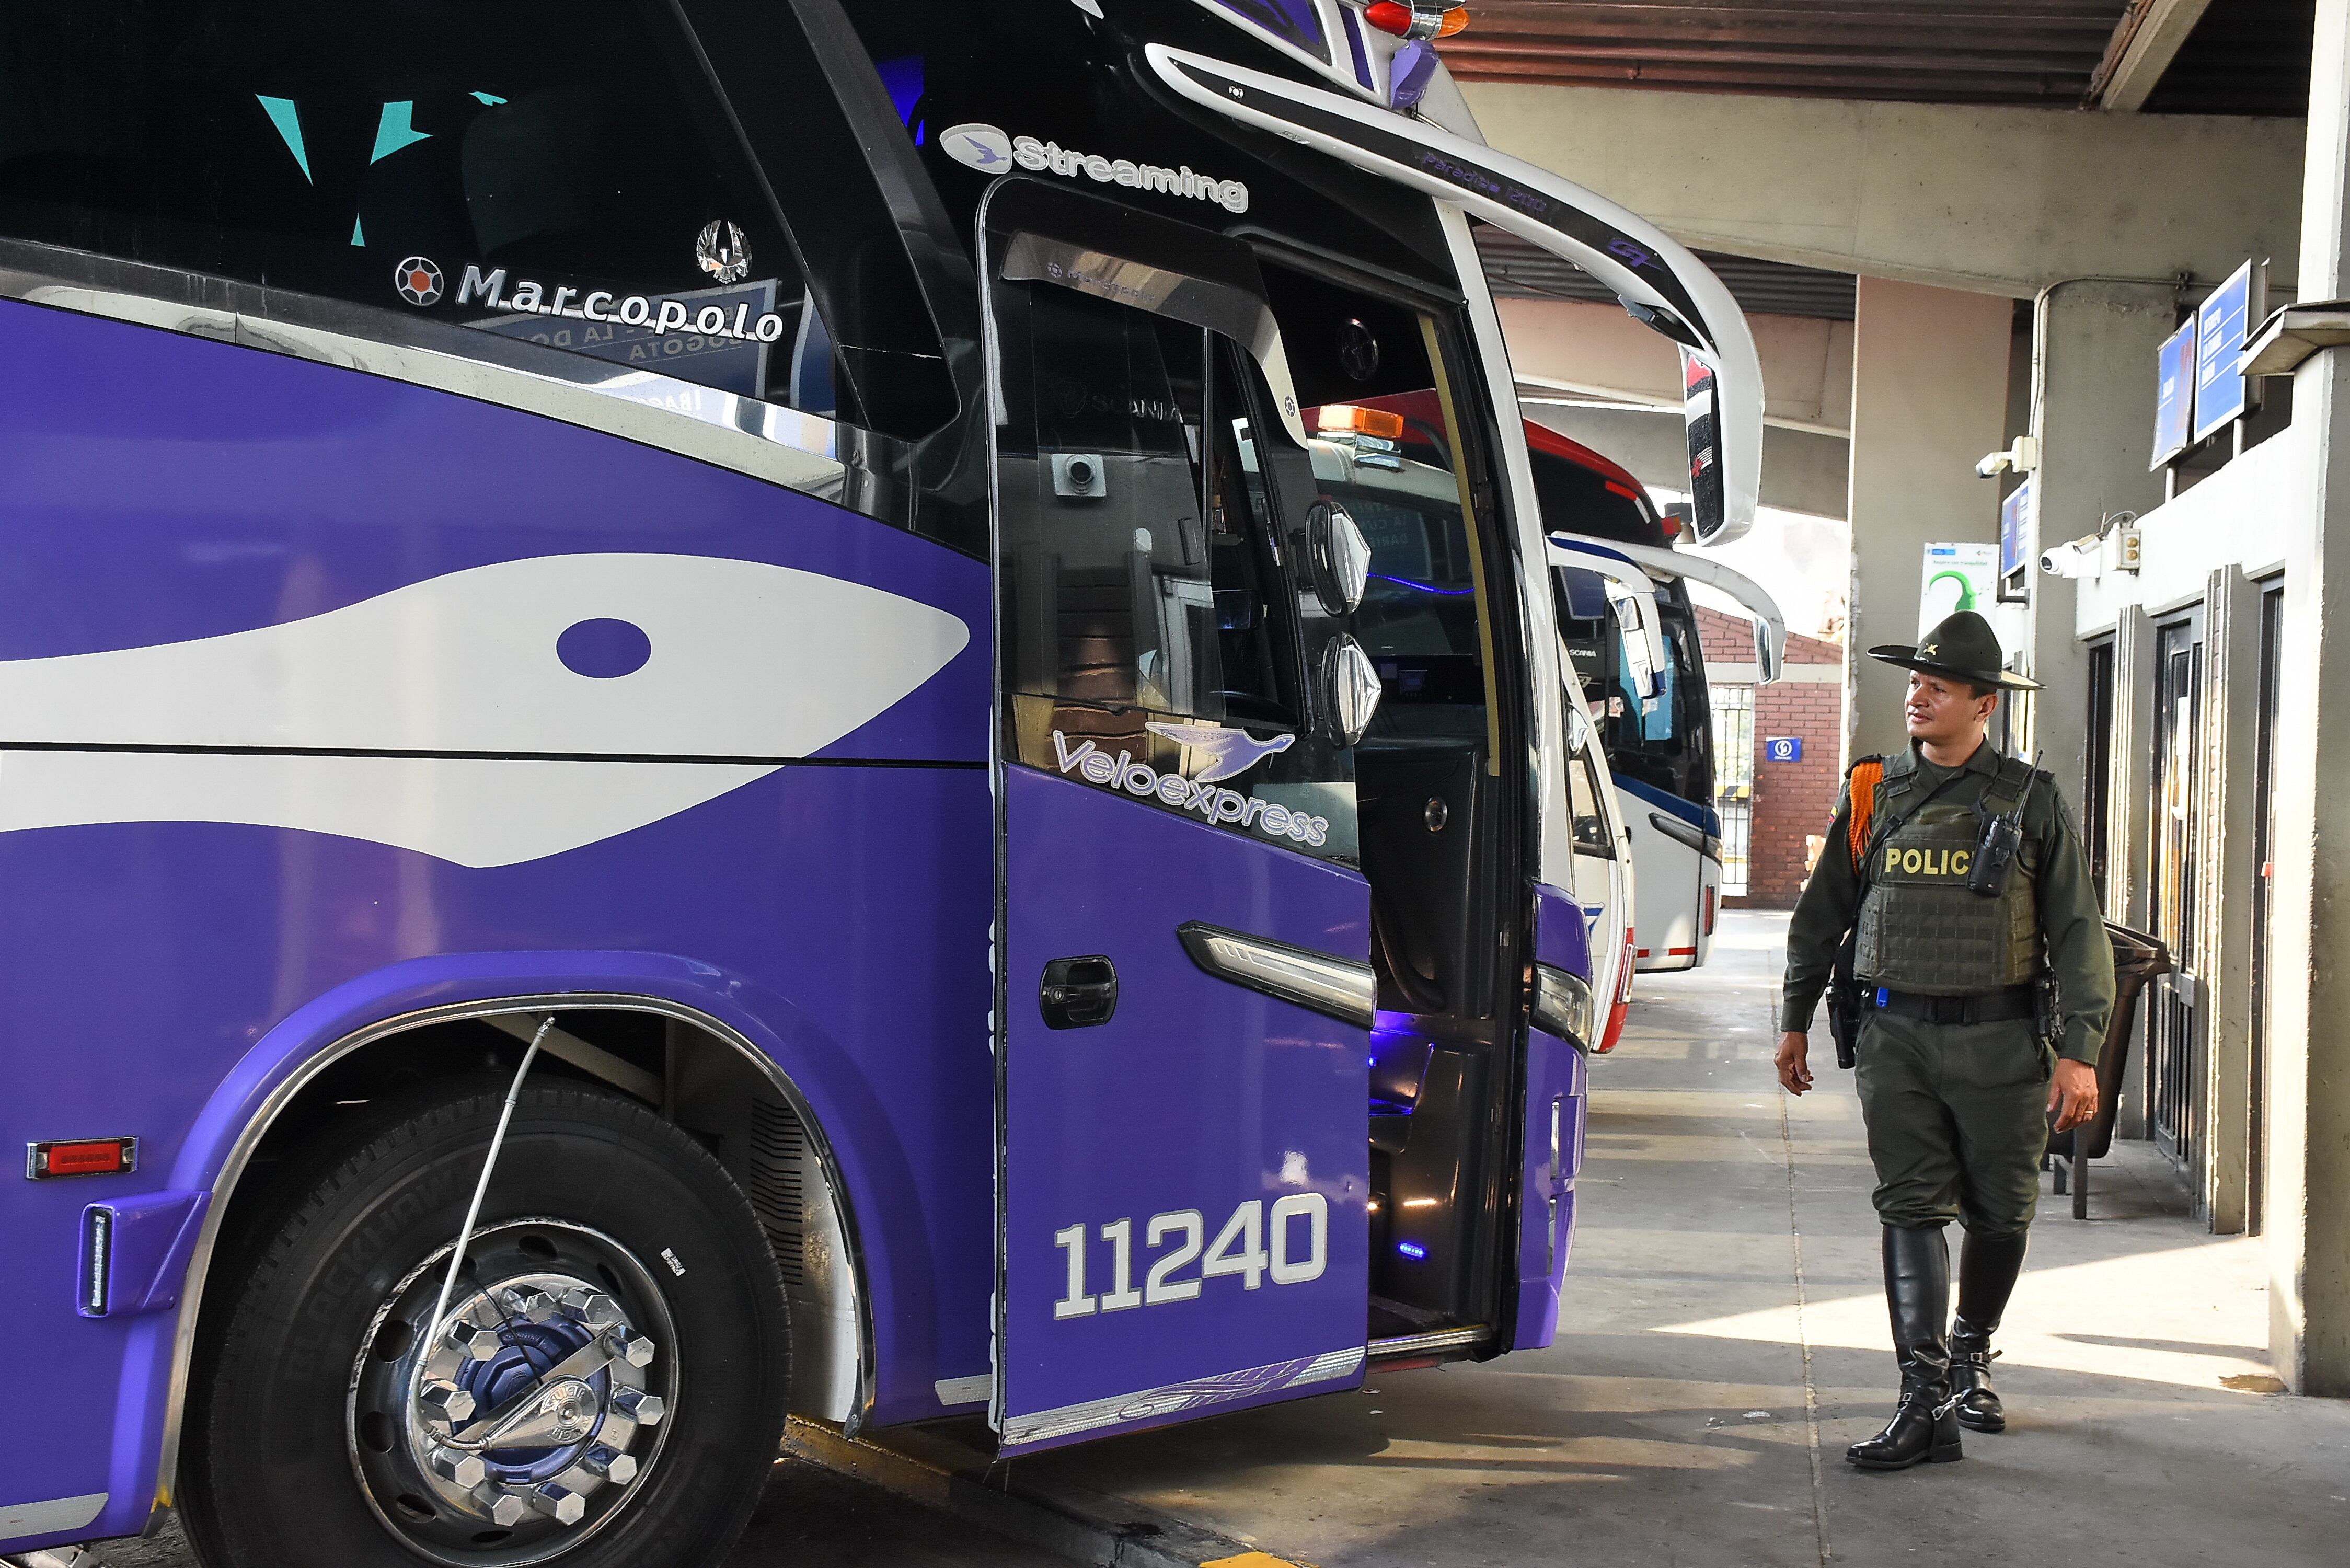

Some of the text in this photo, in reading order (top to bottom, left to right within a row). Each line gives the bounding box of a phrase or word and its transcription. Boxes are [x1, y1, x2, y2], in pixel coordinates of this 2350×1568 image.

[1013, 136, 1248, 213] Streaming
[456, 264, 784, 343] Marcopolo
[1053, 730, 1329, 846] Veloexpress
[1884, 848, 1974, 875] POLIC
[1054, 1192, 1328, 1320] 11240
